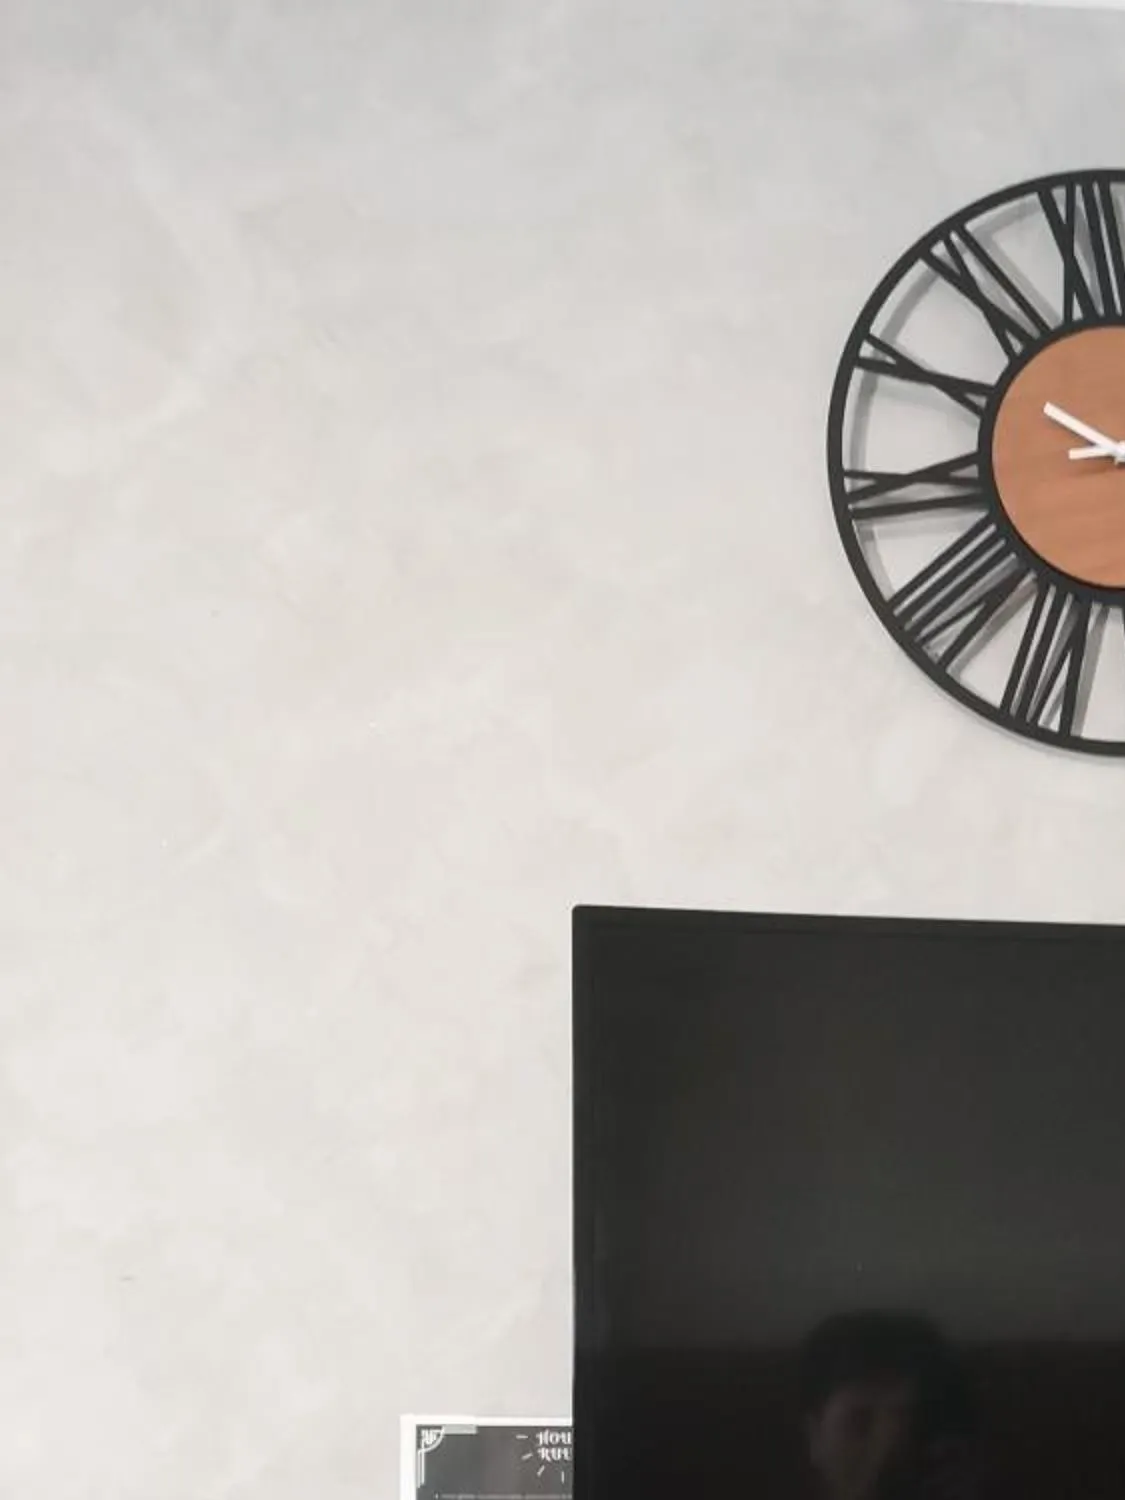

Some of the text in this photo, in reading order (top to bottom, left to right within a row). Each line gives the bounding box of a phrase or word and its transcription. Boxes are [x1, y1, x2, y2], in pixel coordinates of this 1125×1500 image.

[918, 223, 1053, 362] XI
[854, 332, 997, 417] X
[843, 453, 990, 520] IX
[889, 521, 1032, 670] VIII
[1000, 583, 1090, 735] VII
[535, 1429, 572, 1446] HOU
[537, 1447, 572, 1462] RUL
